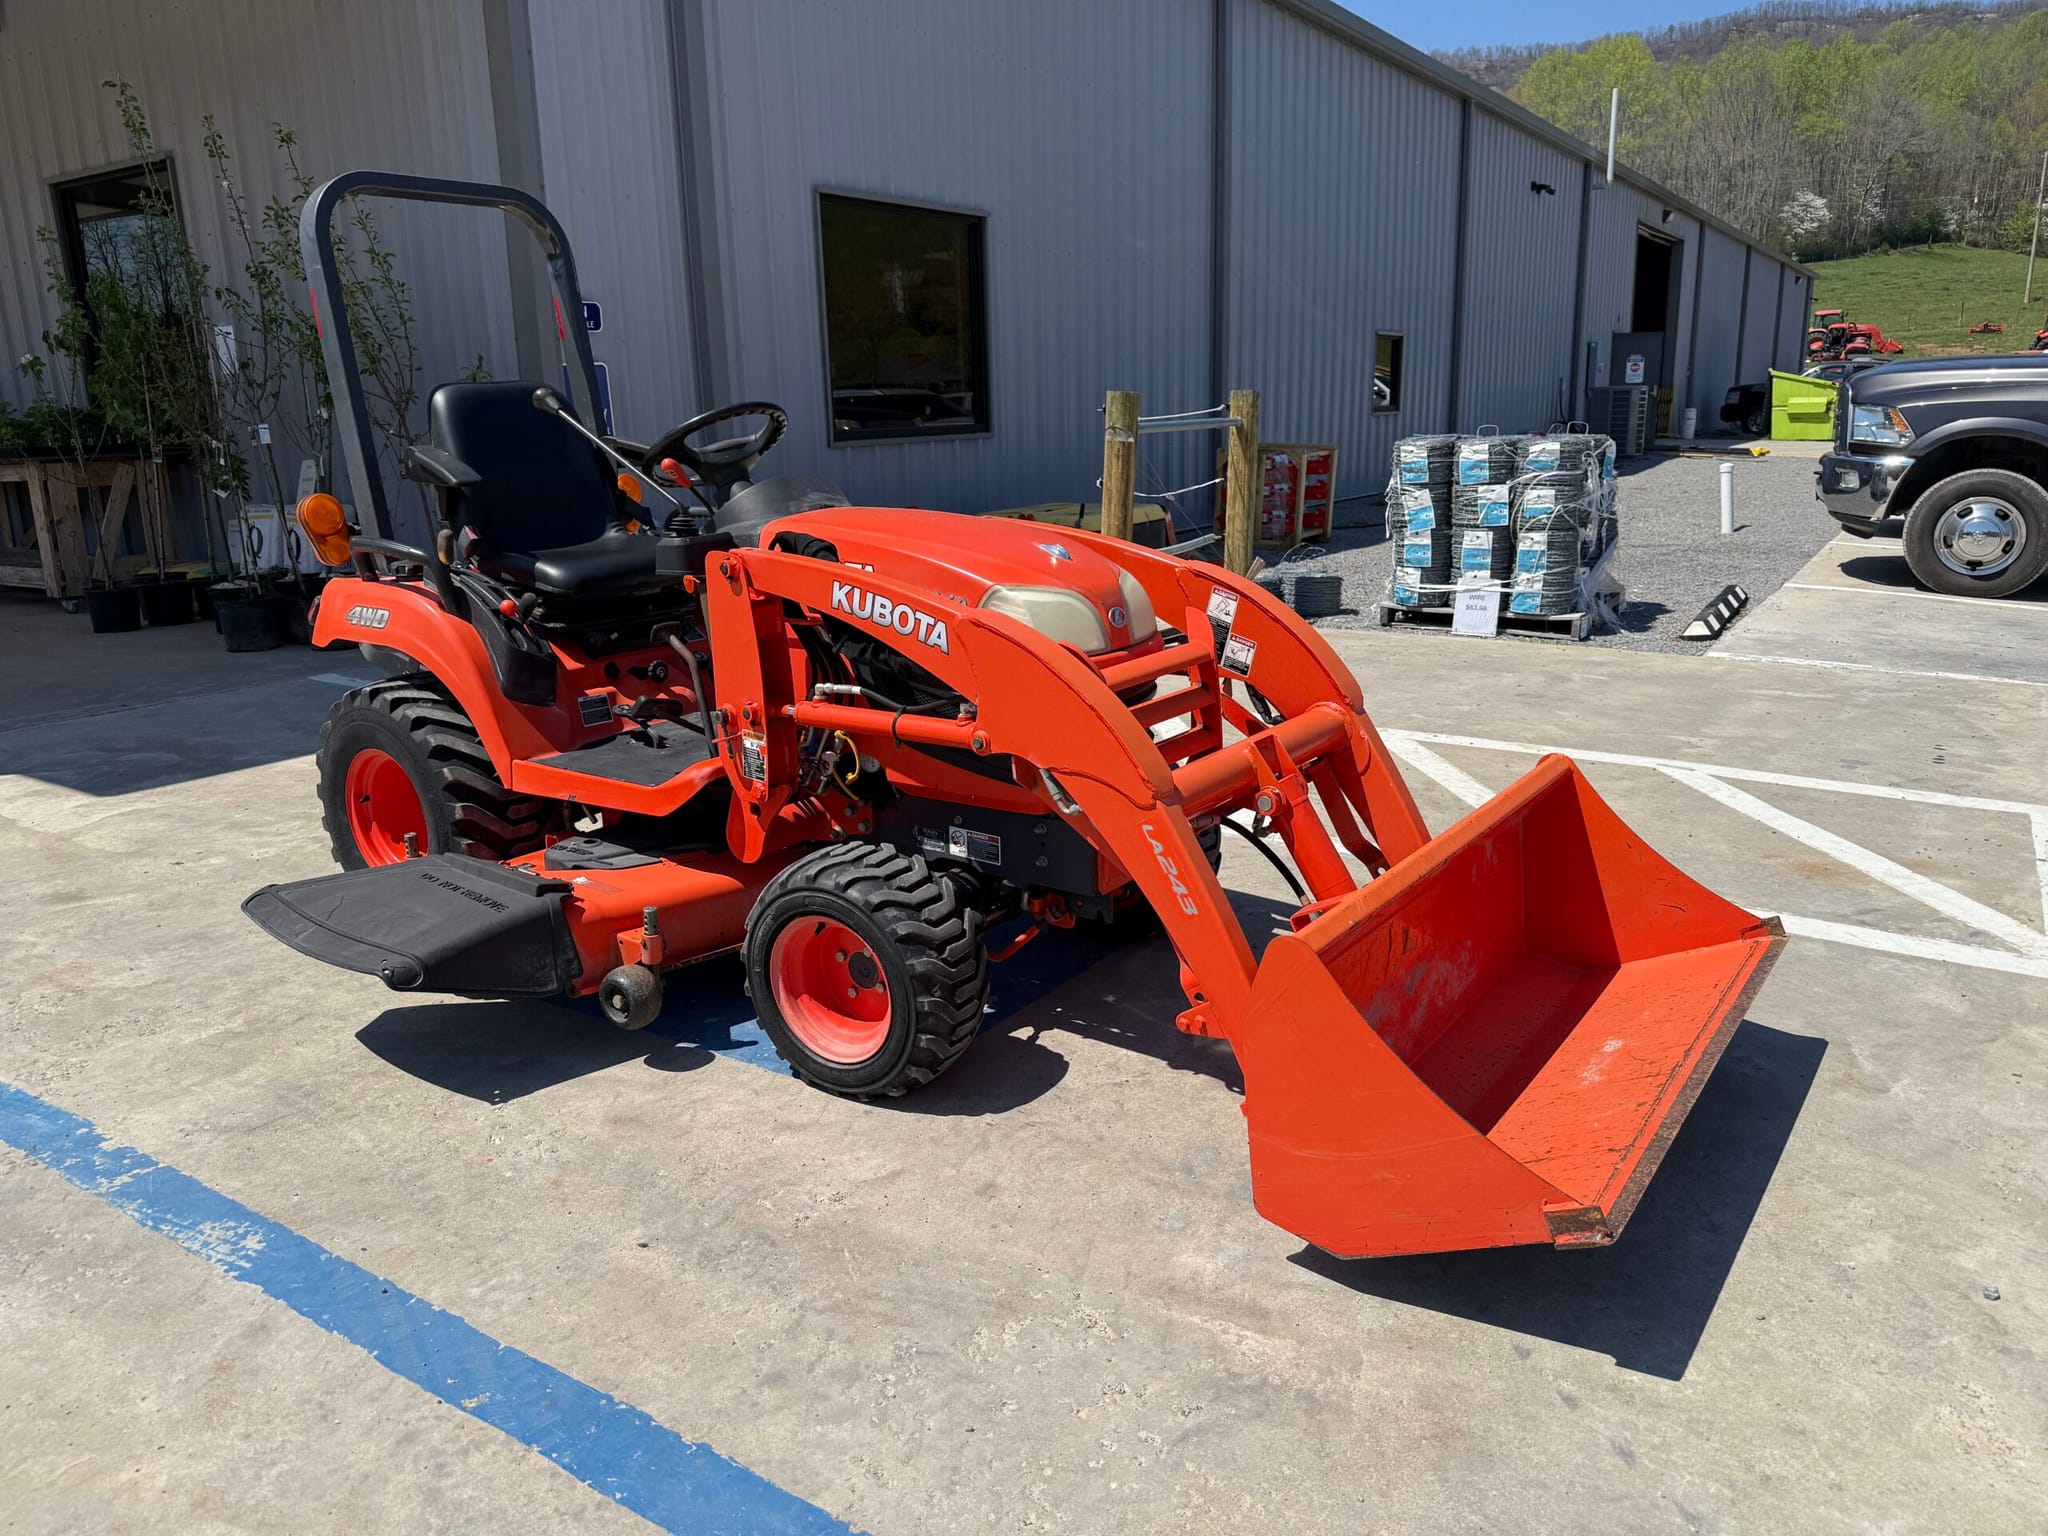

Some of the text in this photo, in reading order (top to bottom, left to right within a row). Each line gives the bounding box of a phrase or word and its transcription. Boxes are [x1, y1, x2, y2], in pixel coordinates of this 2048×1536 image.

[345, 605, 391, 629] 4WD
[831, 579, 950, 656] KUBOTA
[420, 872, 510, 914] DO NOT REMOVE
[1141, 824, 1199, 916] LA243
